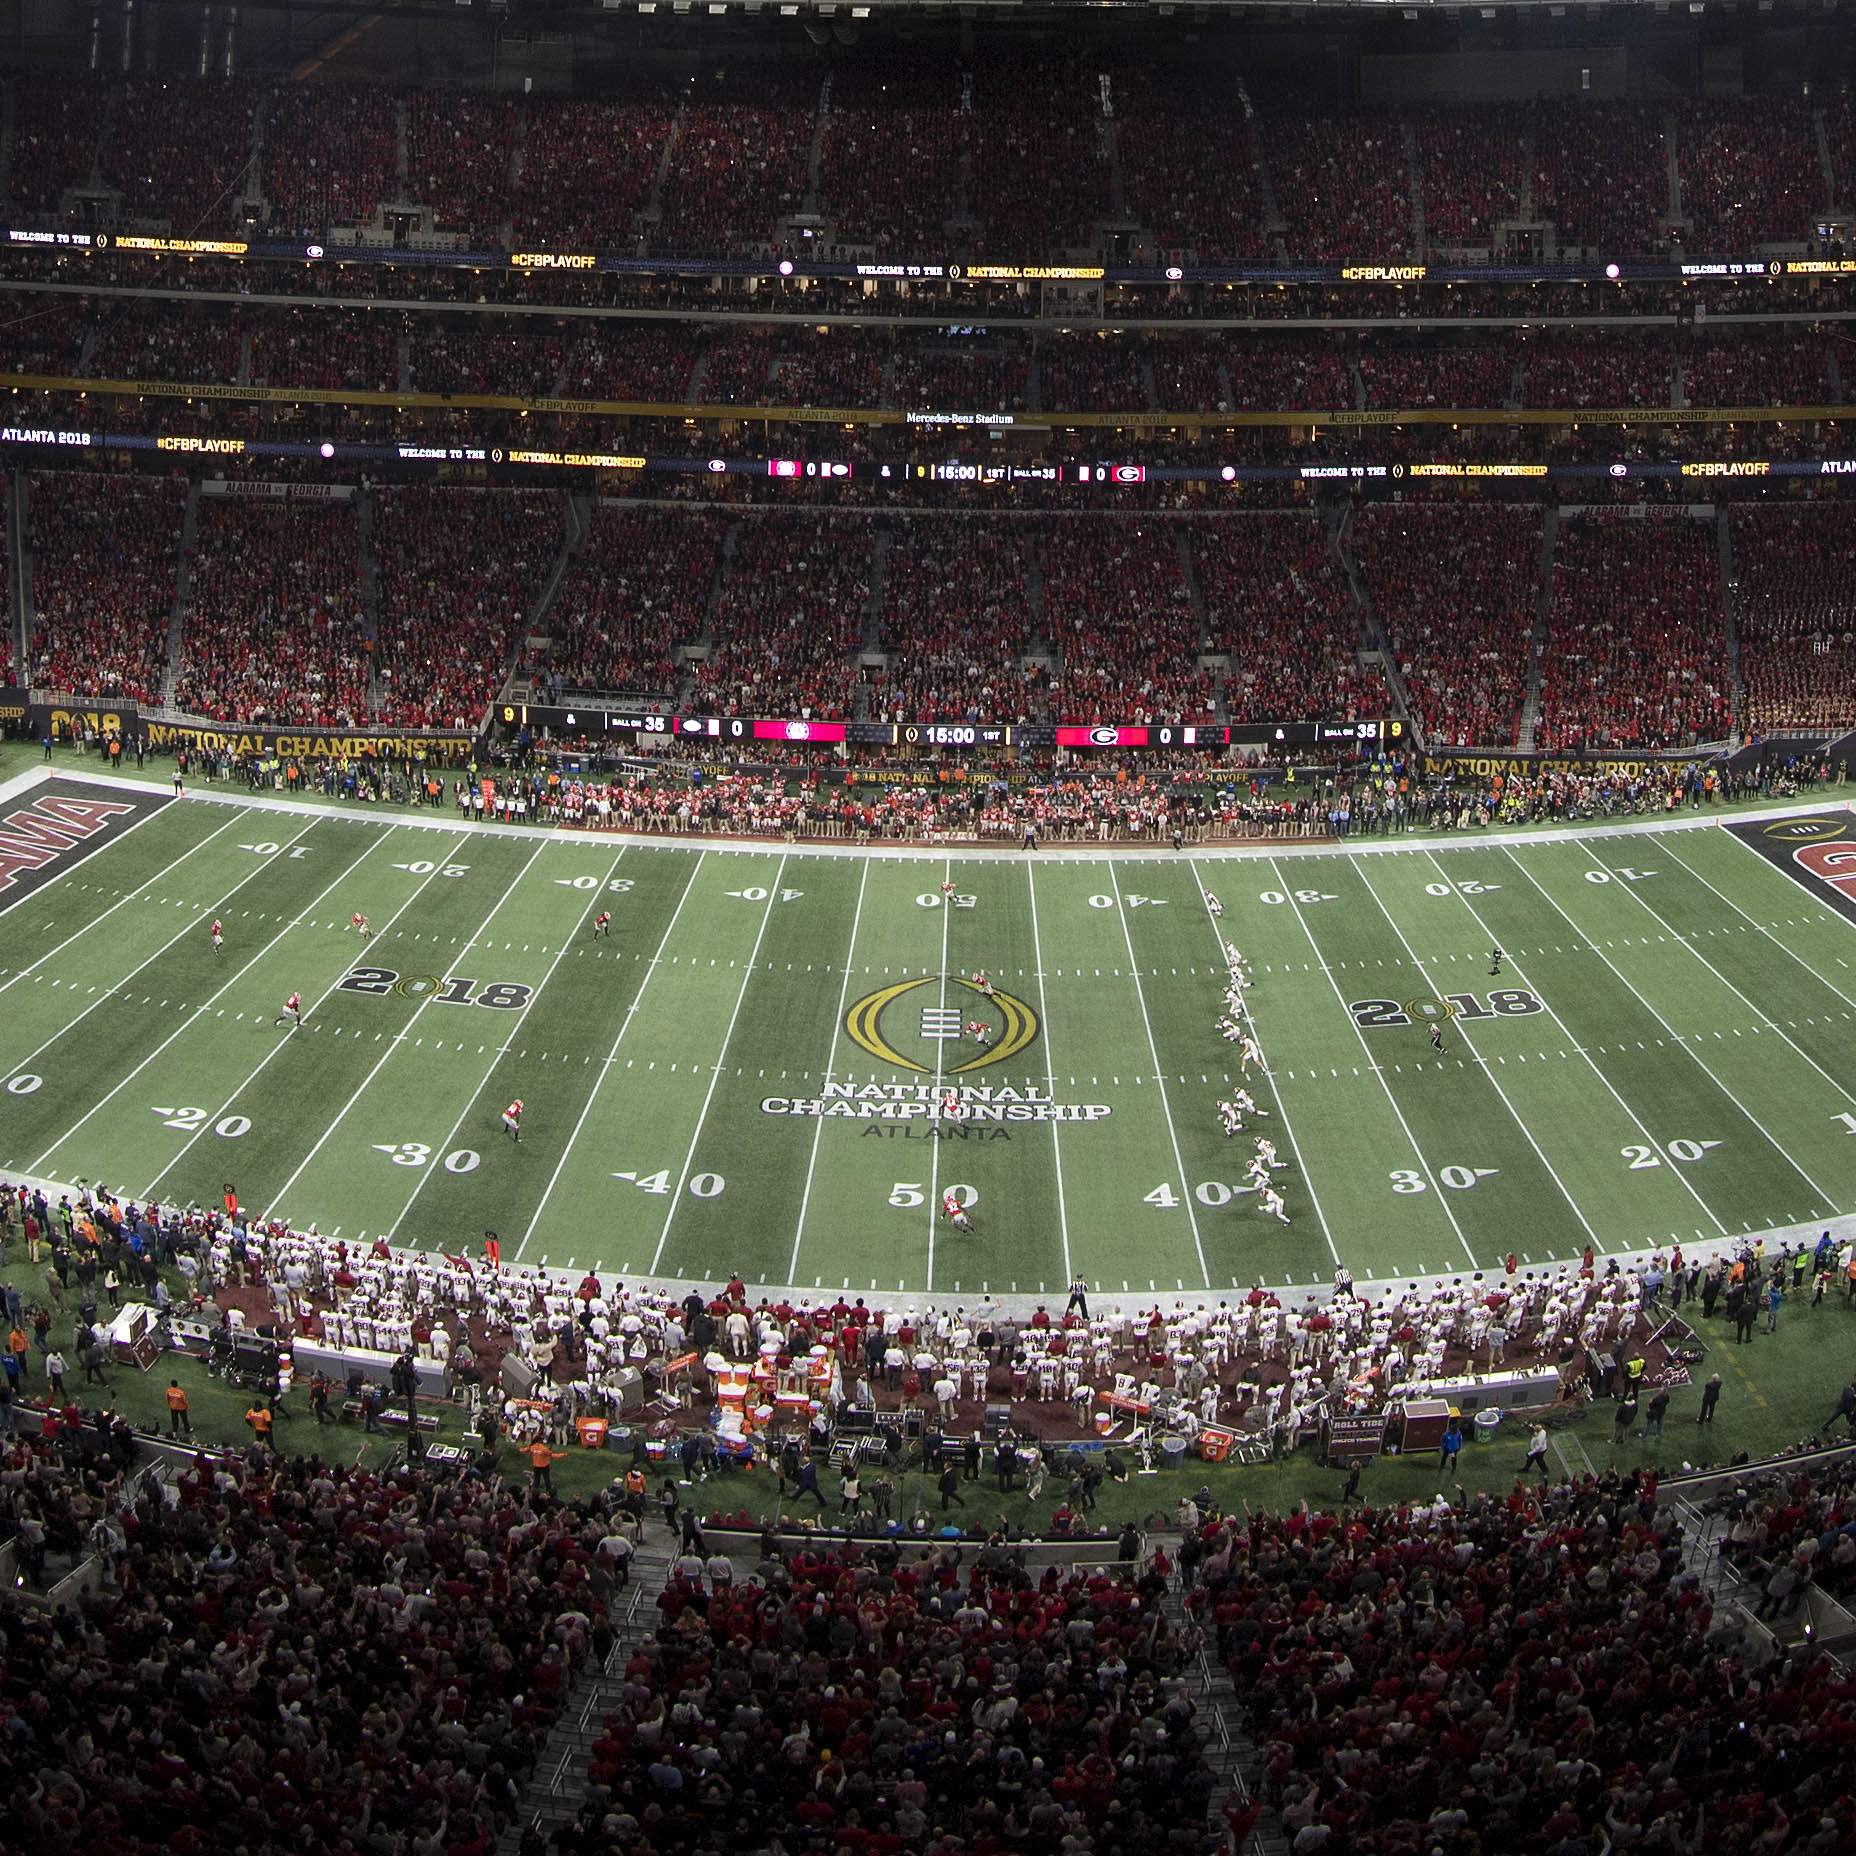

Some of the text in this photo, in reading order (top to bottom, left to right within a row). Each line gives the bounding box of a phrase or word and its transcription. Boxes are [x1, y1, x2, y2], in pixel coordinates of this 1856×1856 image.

[9, 231, 91, 244] WELCOME TO THE
[115, 236, 247, 254] NATIONAL CHAMPIONSHIP
[511, 253, 595, 268] #CFBPLAYOFF
[1787, 261, 1838, 274] NATIONAL
[857, 265, 943, 276] WELCOME TO THE
[967, 266, 1104, 279] NATIONAL CHAMPIONSHIP
[1342, 267, 1426, 280] #CFBPLAYOFF
[1681, 263, 1765, 275] WELCOME TO THE
[137, 383, 191, 396] NATIONAL
[192, 385, 271, 399] CHAMPIONSHIP
[528, 399, 596, 412] #CFBPLAYOFF
[788, 409, 830, 420] ATLANTA
[906, 412, 1014, 424] Mercedes-Benz Stadium
[1098, 415, 1142, 425] ATLANTA
[1329, 412, 1397, 424] #CFBPLAYOFF
[1574, 411, 1708, 422] NATIONAL CHAMPIONSHIP
[1, 427, 91, 445] ATLANTA 2018
[157, 437, 245, 453] #CFBPLAYOFF
[399, 447, 485, 459] WELCOME TO THE
[509, 451, 646, 468] NATIONAL CHAMPIONSHIP
[806, 462, 816, 476] 0
[917, 466, 925, 478] 9
[937, 465, 976, 480] 15:00
[986, 468, 1005, 479] 1ST
[1042, 468, 1056, 479] 35
[1096, 467, 1105, 481] 0
[1301, 466, 1386, 478] WELCOME TO THE
[1410, 465, 1548, 477] NATIONAL CHAMPIONSHIP
[1681, 463, 1770, 476] #CFBPLAYOFF
[225, 482, 331, 496] ALABAMA GEORGIA
[1584, 505, 1689, 517] ALABAMA GEORGIA
[504, 707, 514, 722] 9
[612, 719, 630, 727] BALL
[645, 717, 664, 731] 35
[732, 720, 743, 736] 0
[1324, 729, 1341, 737] BALL
[1356, 723, 1377, 738] 35
[1391, 722, 1401, 736] 9
[148, 724, 275, 756] NATIONAL
[926, 726, 1000, 743] 15:00 1ST
[1160, 728, 1171, 743] 0
[819, 1081, 1052, 1104] NATIONAL
[760, 1095, 1113, 1121] CHAMPIONSHIP
[164, 1106, 252, 1138] 20
[860, 1123, 1012, 1141] ATLANTA
[391, 1142, 481, 1173] 30
[1620, 1138, 1704, 1170] 20
[635, 1169, 726, 1197] 40
[1389, 1165, 1478, 1194] 30
[888, 1182, 979, 1210] 50
[1144, 1181, 1233, 1208] 40
[1334, 1419, 1384, 1429] ROLL TIDE
